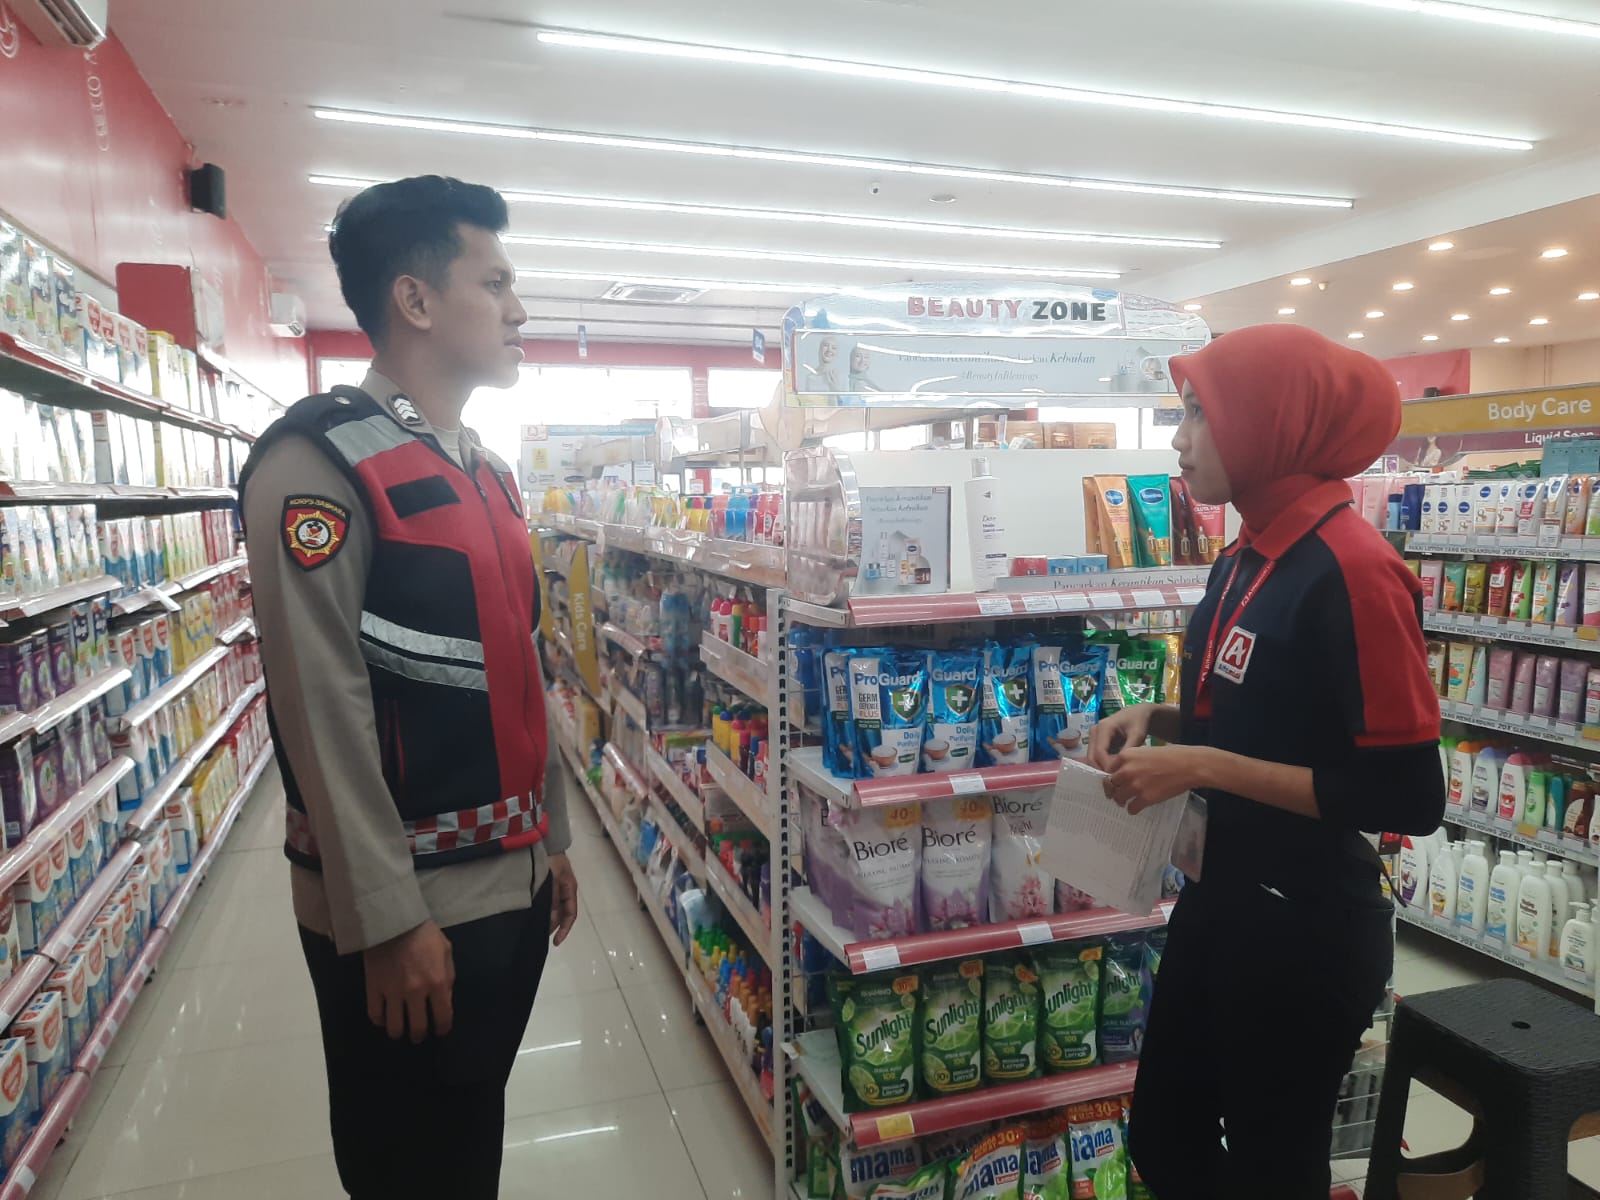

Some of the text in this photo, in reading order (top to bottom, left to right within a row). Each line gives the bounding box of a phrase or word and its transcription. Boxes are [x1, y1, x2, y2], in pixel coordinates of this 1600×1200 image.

[907, 296, 1106, 322] BEAUTY ZONE
[1488, 397, 1592, 422] Body Care
[1167, 574, 1207, 584] Sebarka
[574, 592, 588, 650] Kids Care
[854, 671, 923, 686] ProGuard
[858, 692, 879, 703] GERM
[853, 832, 910, 861] Bioré
[922, 823, 976, 848] Bioré
[1045, 980, 1095, 1014] unlight
[1106, 973, 1141, 995] nlight
[985, 992, 1027, 1025] unlight
[855, 1013, 912, 1058] Sunlight
[925, 1000, 980, 1045] Sunlight
